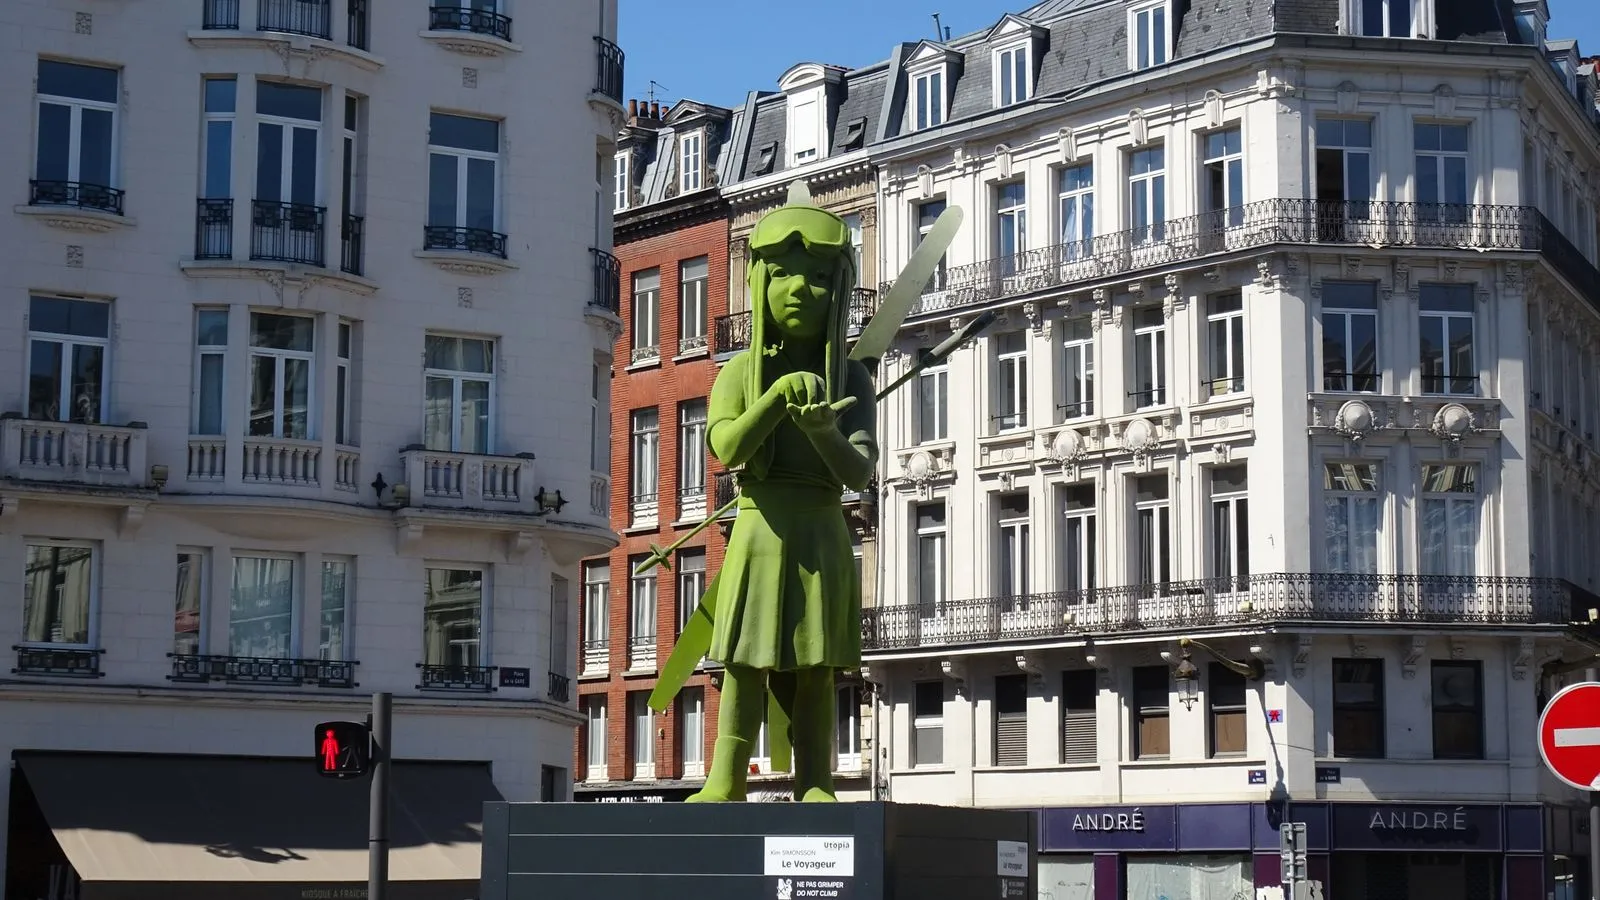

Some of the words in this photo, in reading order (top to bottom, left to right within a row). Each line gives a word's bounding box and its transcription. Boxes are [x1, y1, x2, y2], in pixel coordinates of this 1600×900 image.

[1072, 807, 1144, 831] ANDRÉ
[1369, 806, 1467, 830] ANDRÉ
[823, 842, 850, 851] Utopia
[782, 860, 792, 868] Le
[794, 860, 836, 869] Voyageur
